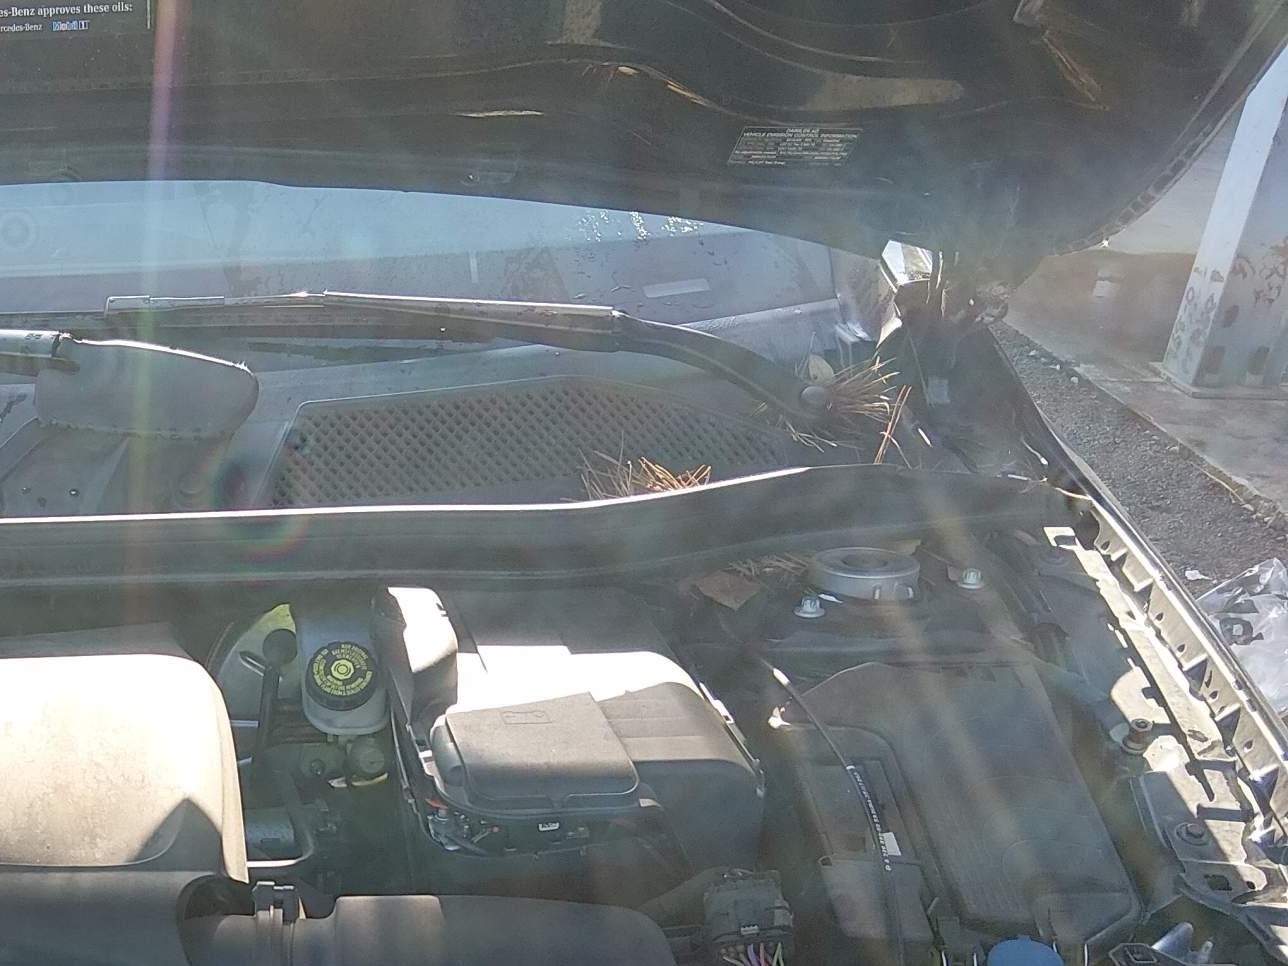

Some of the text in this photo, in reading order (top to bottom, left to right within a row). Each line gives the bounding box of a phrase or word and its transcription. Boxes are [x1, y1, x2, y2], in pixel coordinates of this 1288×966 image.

[37, 5, 81, 17] approves
[83, 3, 110, 13] these
[111, 1, 133, 12] oils:
